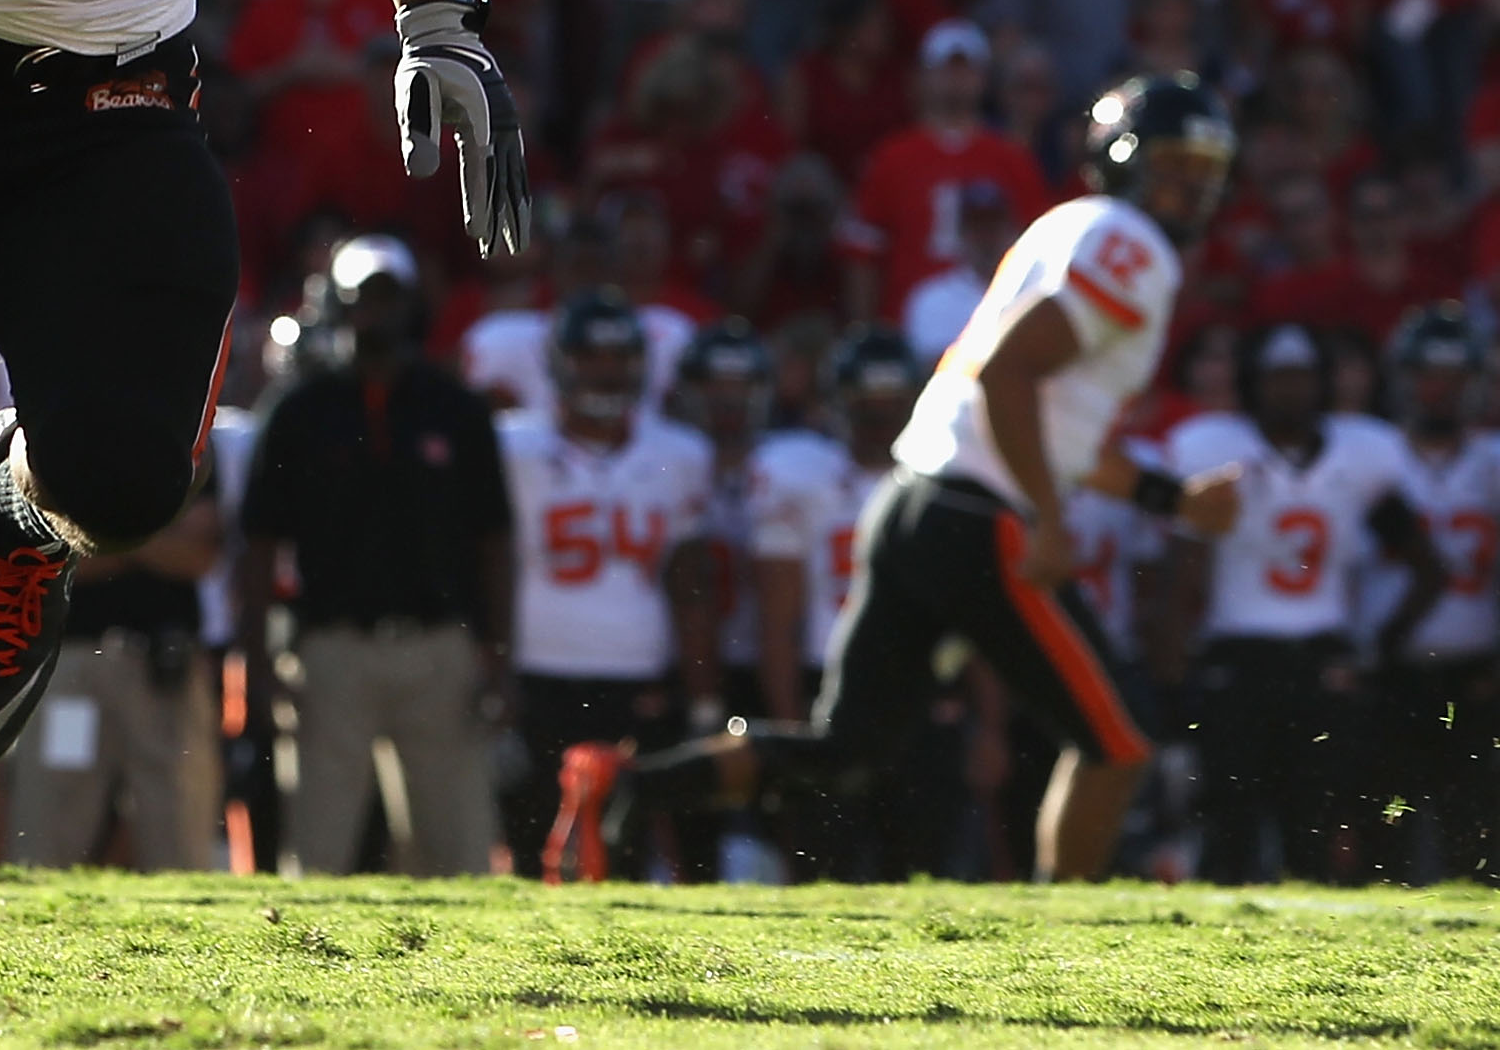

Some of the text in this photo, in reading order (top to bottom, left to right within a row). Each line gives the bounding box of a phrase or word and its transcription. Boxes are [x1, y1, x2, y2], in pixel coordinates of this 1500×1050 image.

[1095, 231, 1151, 289] 12
[545, 502, 667, 586] 54
[1266, 510, 1327, 595] 3
